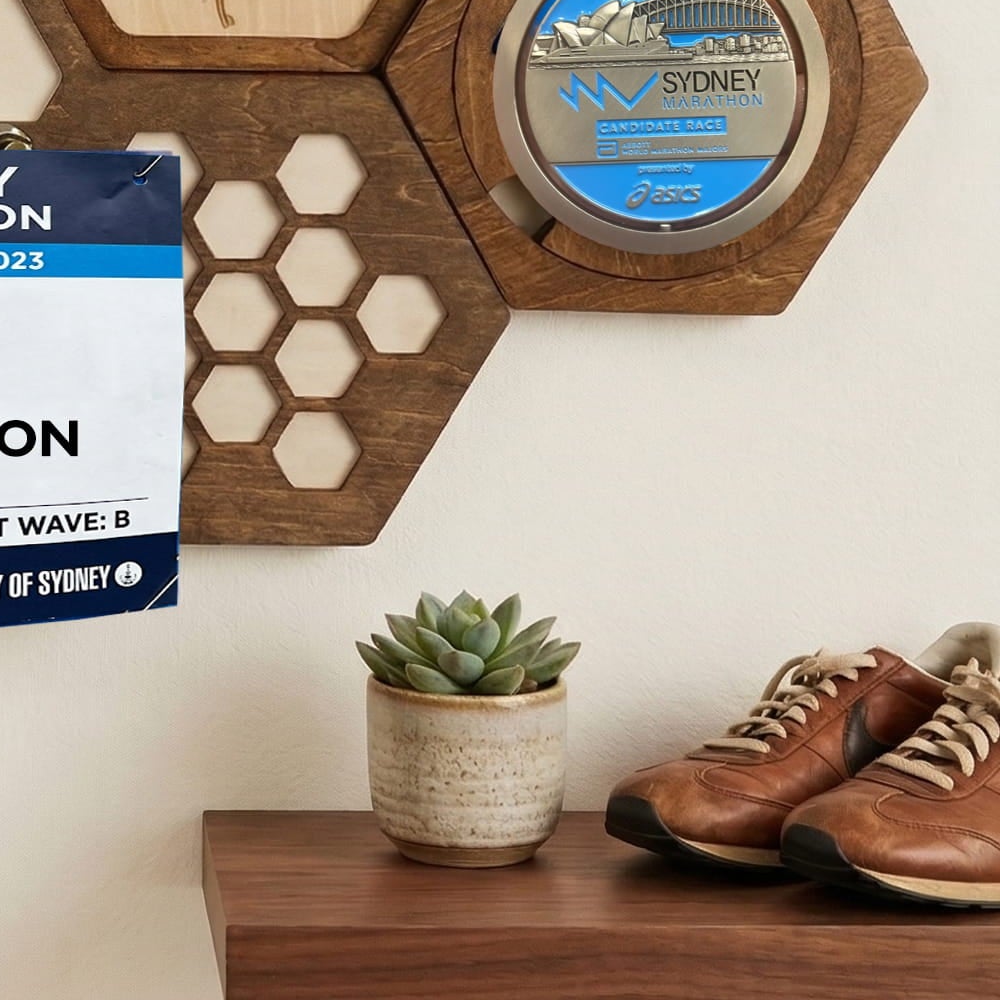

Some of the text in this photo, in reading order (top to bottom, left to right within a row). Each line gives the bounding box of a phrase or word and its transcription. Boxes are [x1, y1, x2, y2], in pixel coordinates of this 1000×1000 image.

[662, 69, 761, 94] SYDNEY
[662, 94, 763, 109] MARATHON
[600, 119, 722, 134] CANDIDATE RACE
[18, 512, 106, 536] WAVE:
[114, 510, 131, 529] B
[8, 572, 33, 598] OF
[37, 565, 112, 596] SYDNEY
